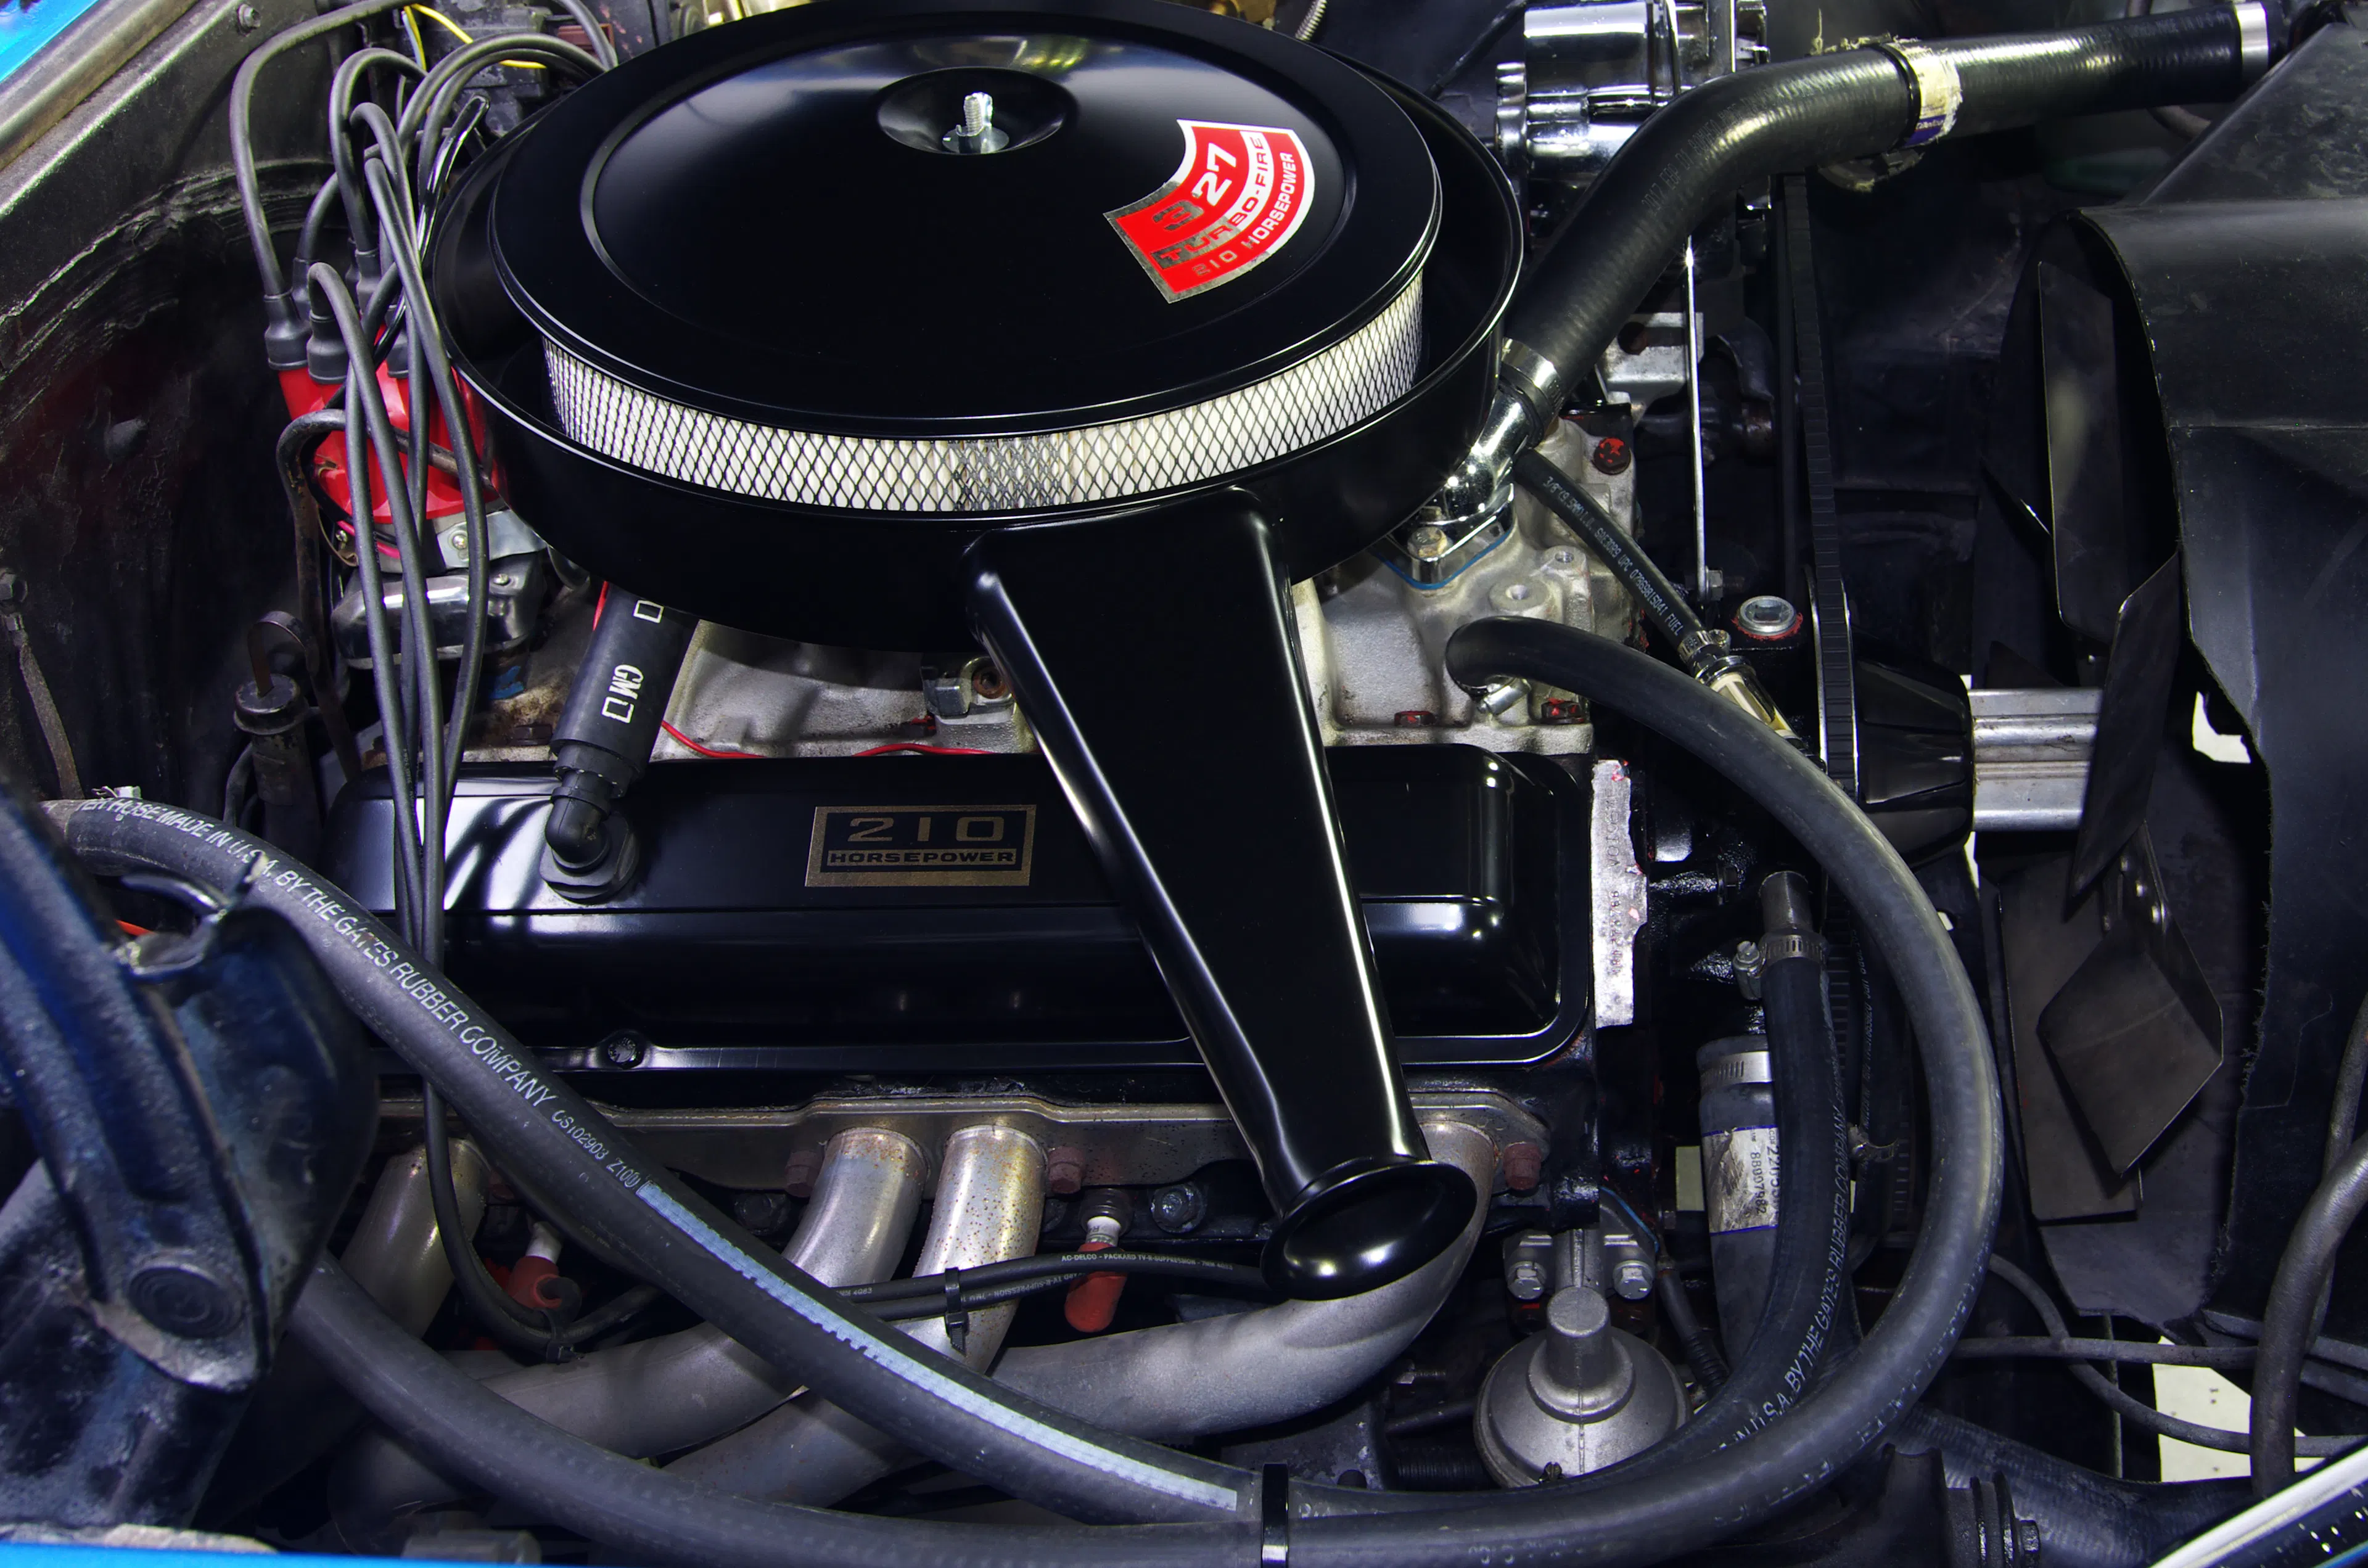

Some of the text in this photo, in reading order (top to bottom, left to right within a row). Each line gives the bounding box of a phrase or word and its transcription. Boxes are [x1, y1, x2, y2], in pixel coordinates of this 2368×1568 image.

[1152, 142, 1237, 231] 327
[1159, 136, 1268, 262] TURBO-FIRE
[1192, 152, 1297, 277] 210 HORSEPOWER
[1618, 554, 1634, 573] UPC
[1664, 612, 1684, 637] FUEL
[608, 663, 644, 700] GM
[829, 852, 1014, 864] HORSEPOWER
[847, 816, 1005, 842] 210
[155, 808, 212, 844] MADE
[204, 829, 234, 850] IN
[274, 870, 313, 893] BY
[302, 883, 347, 922] THE
[334, 916, 393, 968] GATES
[389, 960, 470, 1032] RUBBER
[458, 1025, 558, 1108] COMPANY
[1061, 1253, 1097, 1263] AC-DELCO
[1103, 1252, 1137, 1262] PACKARD
[1784, 1359, 1806, 1394] BY
[1798, 1324, 1824, 1368] THE
[1814, 1267, 1841, 1331] GATES
[1828, 1192, 1849, 1271] RUBBER
